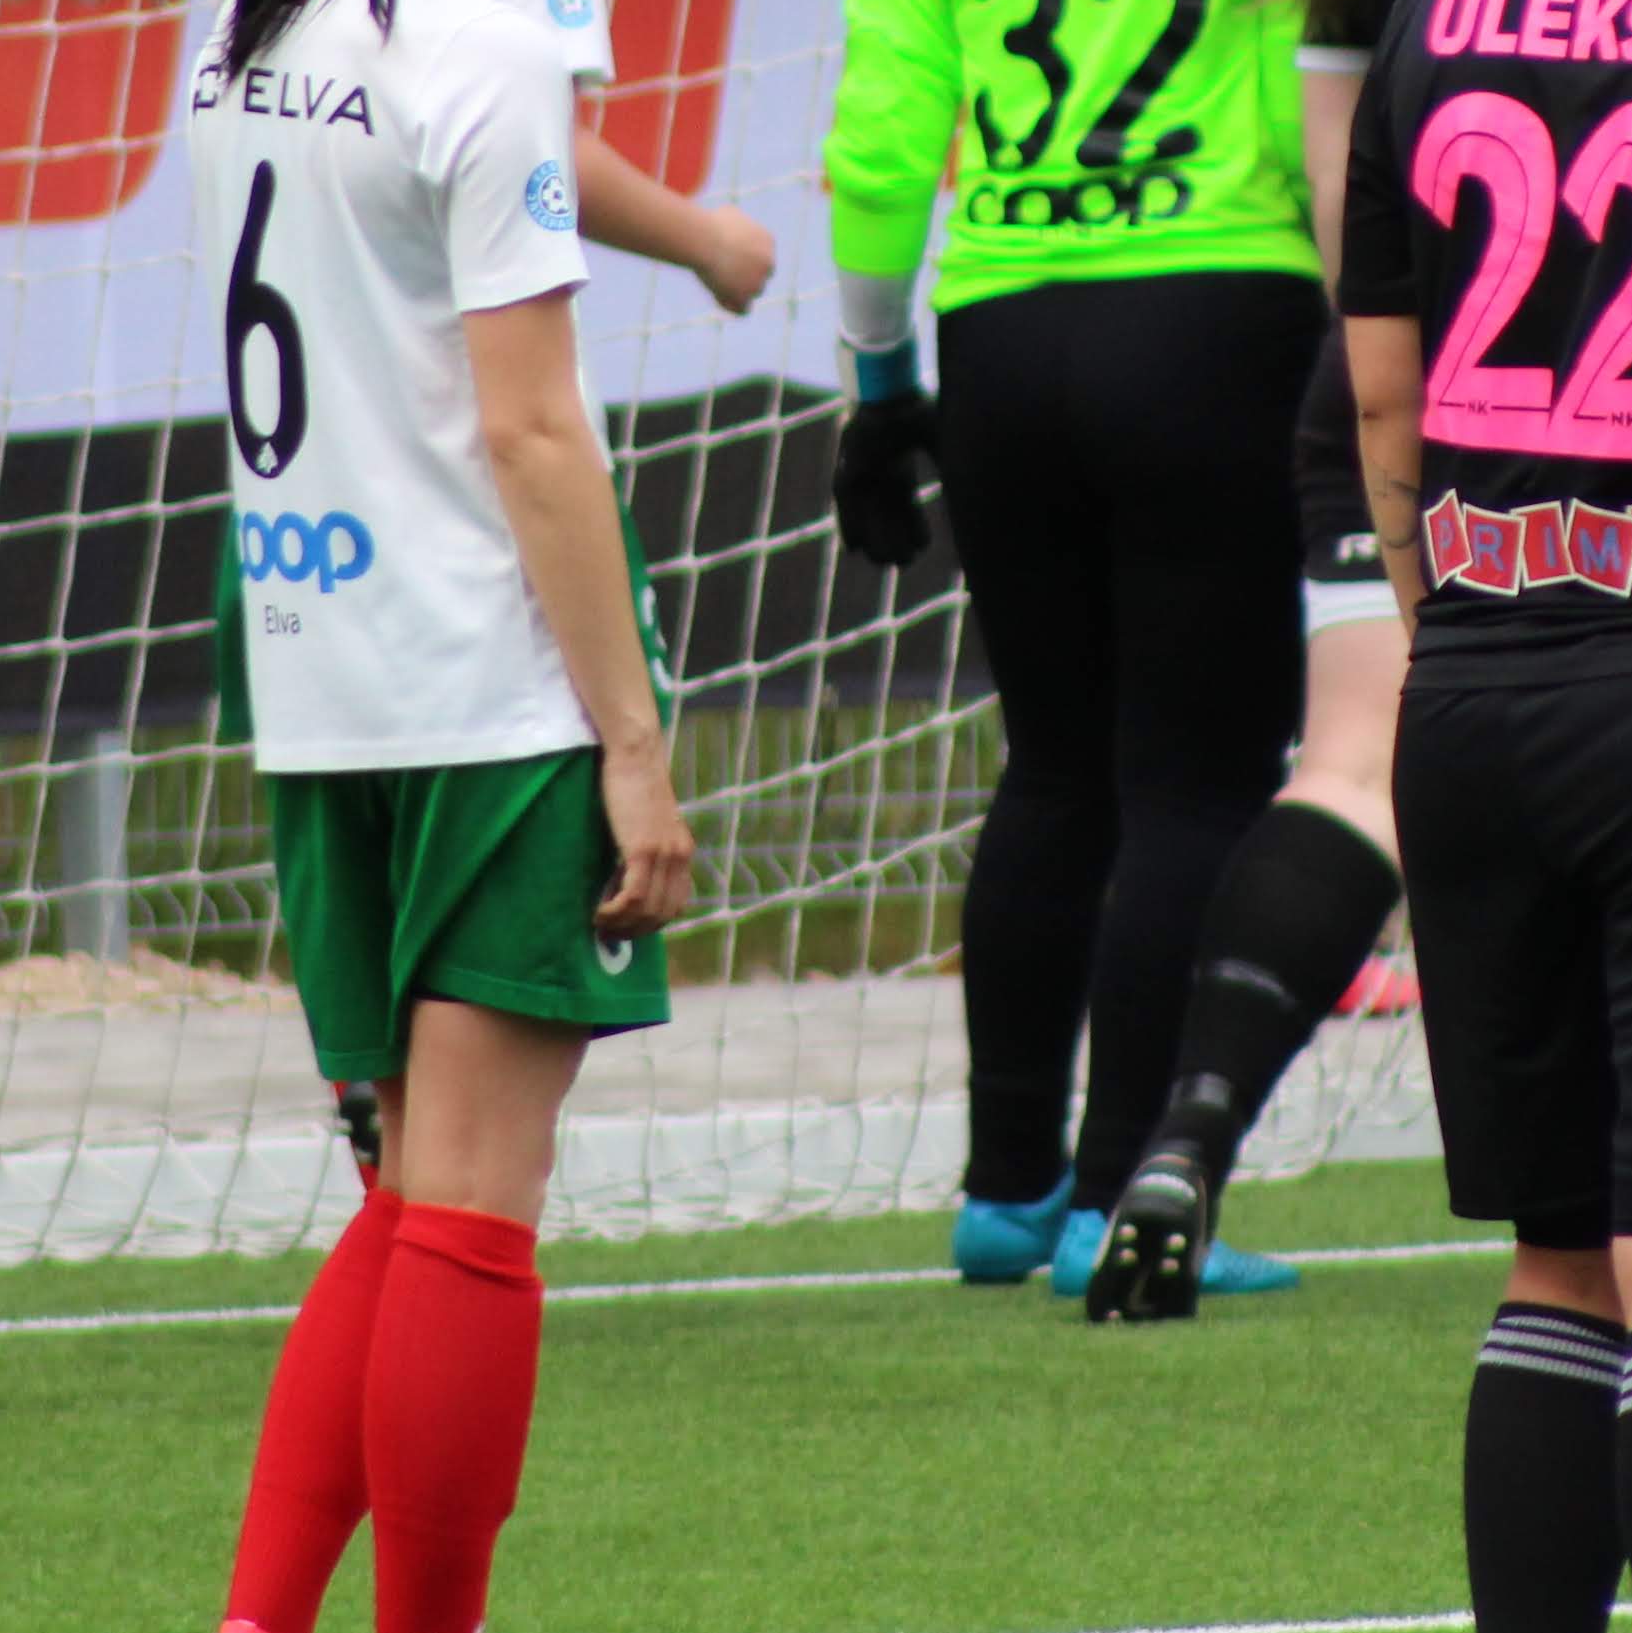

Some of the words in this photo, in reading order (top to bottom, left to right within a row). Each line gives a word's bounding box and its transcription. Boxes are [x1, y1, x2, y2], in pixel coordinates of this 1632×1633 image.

[243, 68, 375, 137] ELVA
[968, 170, 1193, 227] coop
[226, 160, 308, 478] 6
[238, 510, 375, 594] oop
[265, 604, 302, 635] Elva
